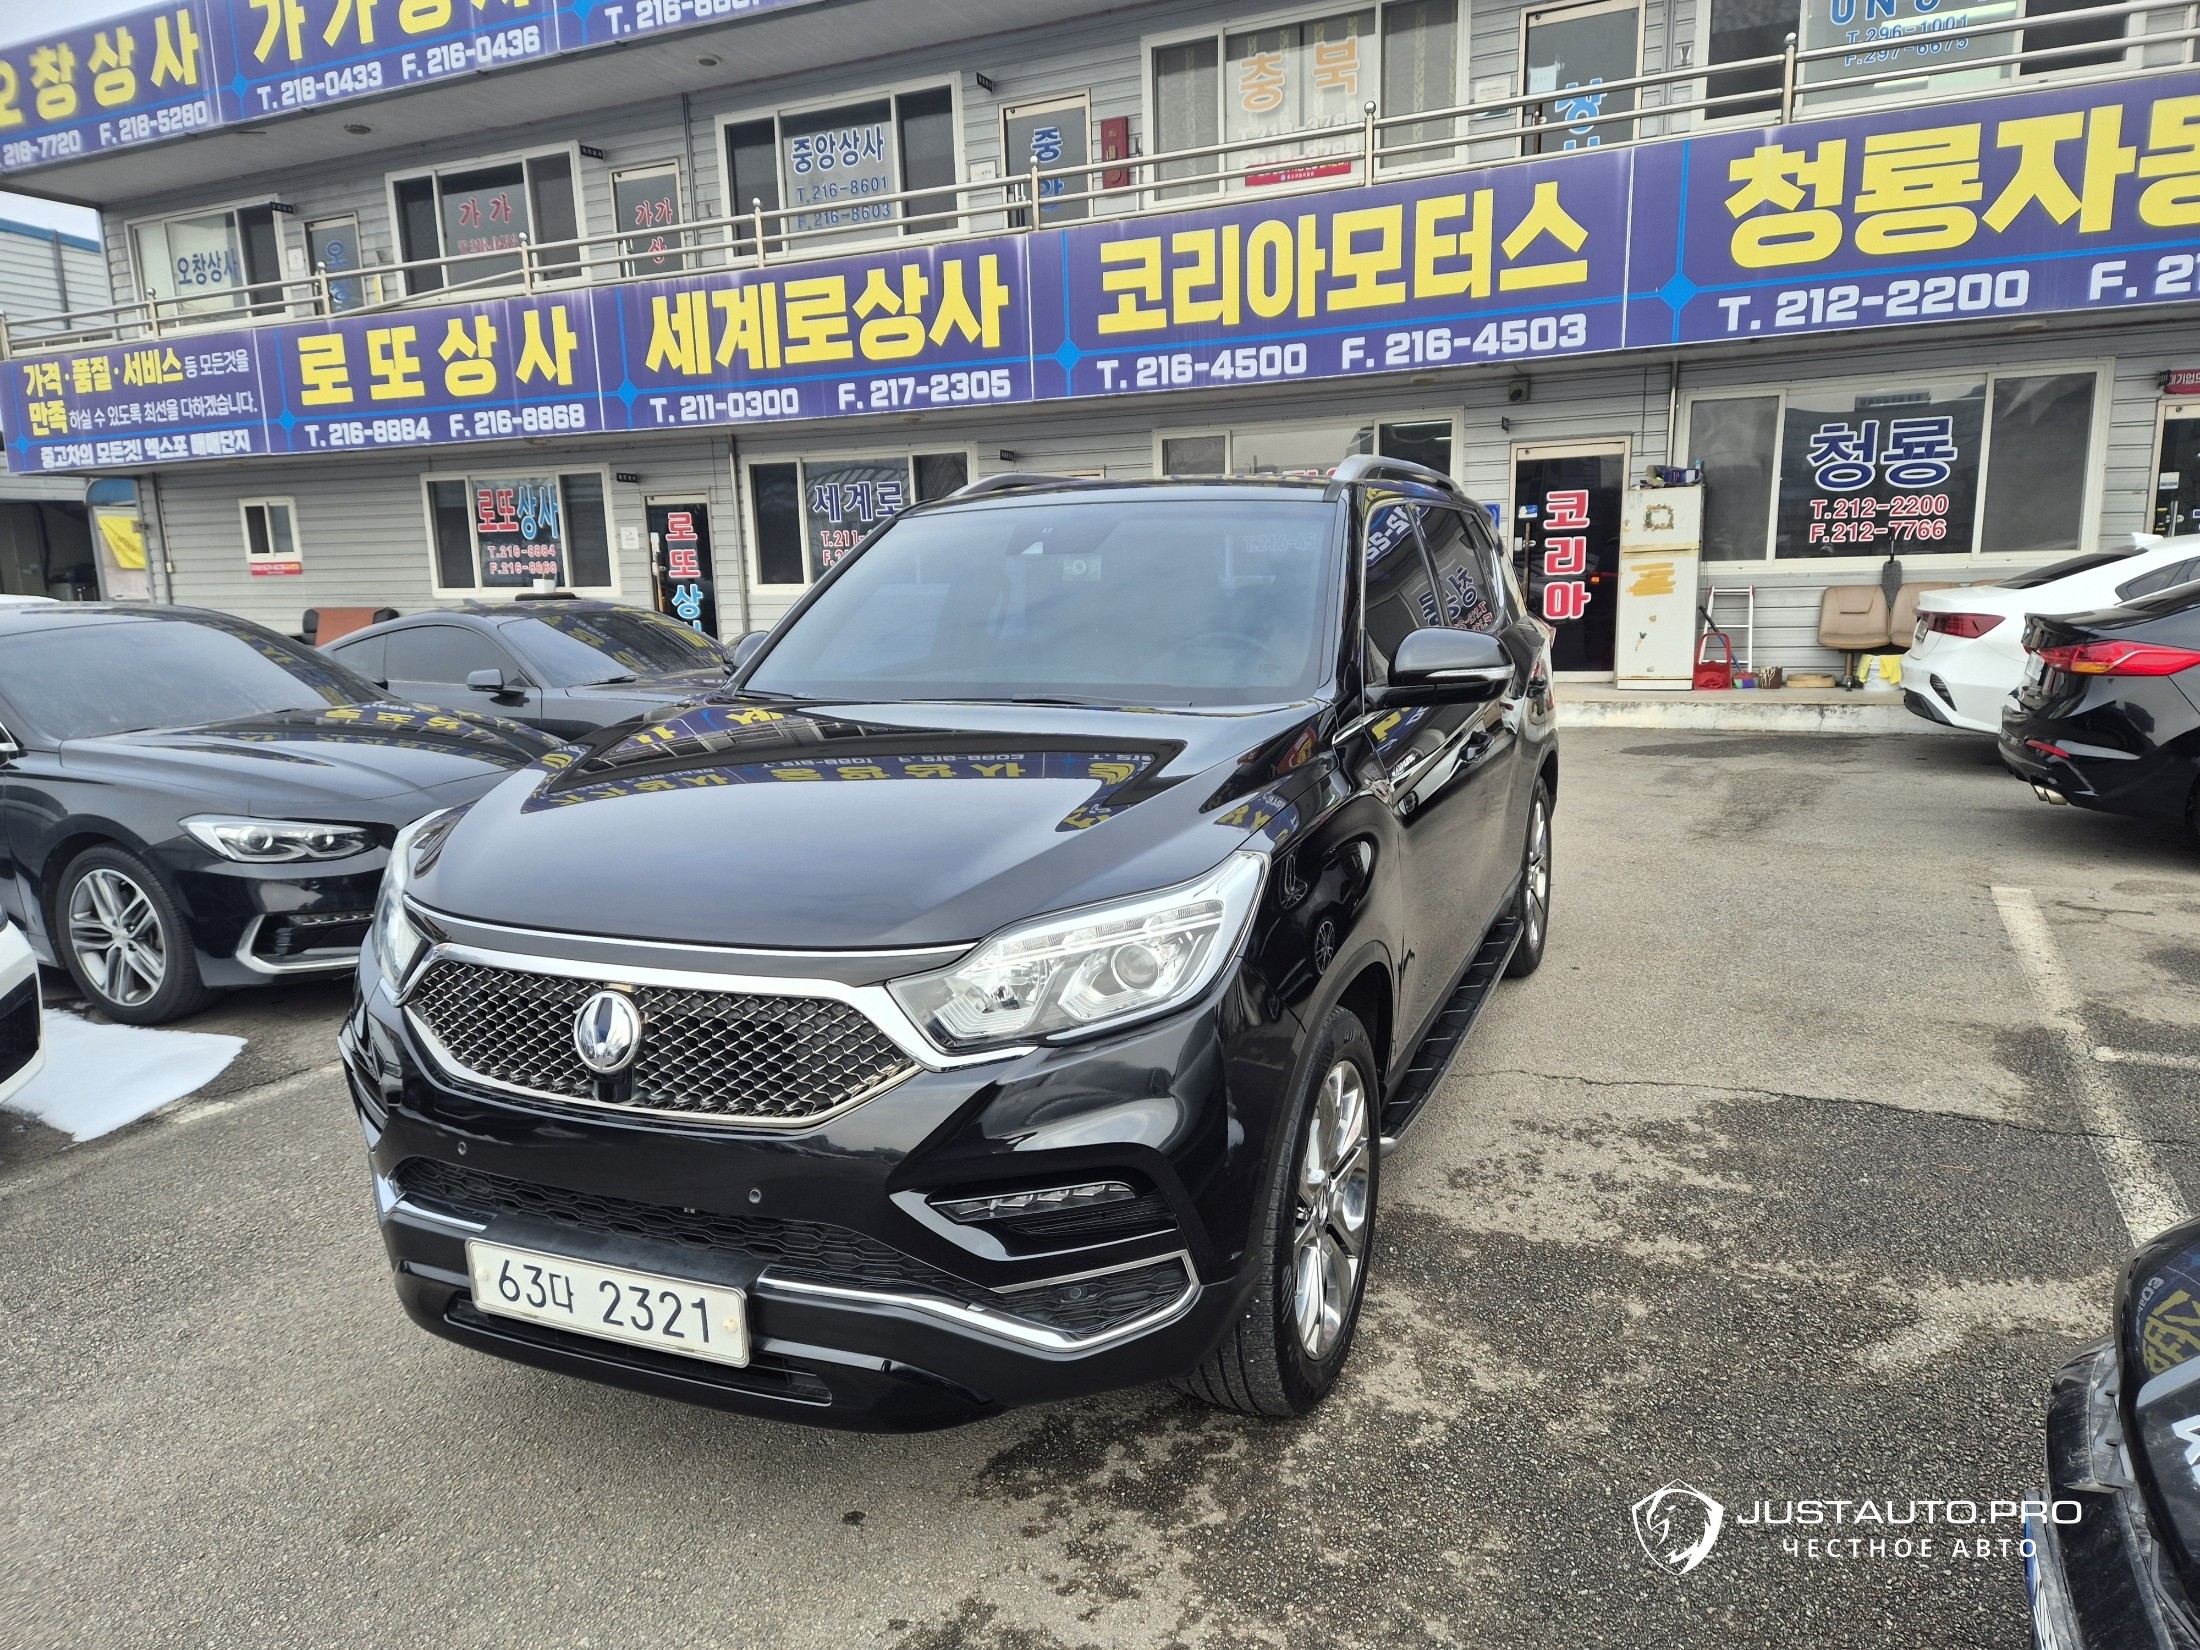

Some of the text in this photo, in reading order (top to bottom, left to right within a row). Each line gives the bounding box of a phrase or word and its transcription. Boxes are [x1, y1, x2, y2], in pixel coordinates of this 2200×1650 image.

[249, 0, 531, 62] 가가
[604, 5, 631, 34] T.
[256, 25, 541, 110] T. 218-0433 F. 216-0436
[1238, 35, 1361, 114] 충북
[3, 100, 207, 166] 218-7720 F. 218-5280
[790, 123, 886, 175] 중앙상사
[458, 191, 513, 229] 가가
[635, 197, 673, 228] 가가
[795, 174, 889, 204] T.216-8601
[177, 247, 241, 286] 오창상사
[1097, 181, 1590, 334] 코리아모터스
[645, 253, 1010, 375] 세계로상사
[1718, 252, 2200, 332] T. 212-2200 F. 2
[184, 356, 198, 379] 등
[200, 348, 250, 379] 모든것을
[298, 305, 577, 406] 로또상사
[1096, 313, 1588, 389] T. 216-4500 F. 216-4503
[94, 407, 106, 428] 수
[107, 402, 143, 428] 있도록
[144, 398, 180, 423] 최선을
[649, 368, 1012, 423] T. 211-0300 F. 217-2305
[304, 403, 587, 448] T. 216-8884 F. 216-8868
[1806, 415, 1958, 492] 청룡
[476, 484, 559, 541] 로또상사
[1808, 518, 1947, 544] F.212-7766
[1809, 493, 1950, 521] T.212-2200
[1543, 489, 1592, 620] 코리아
[499, 1259, 710, 1344] 63다 2321
